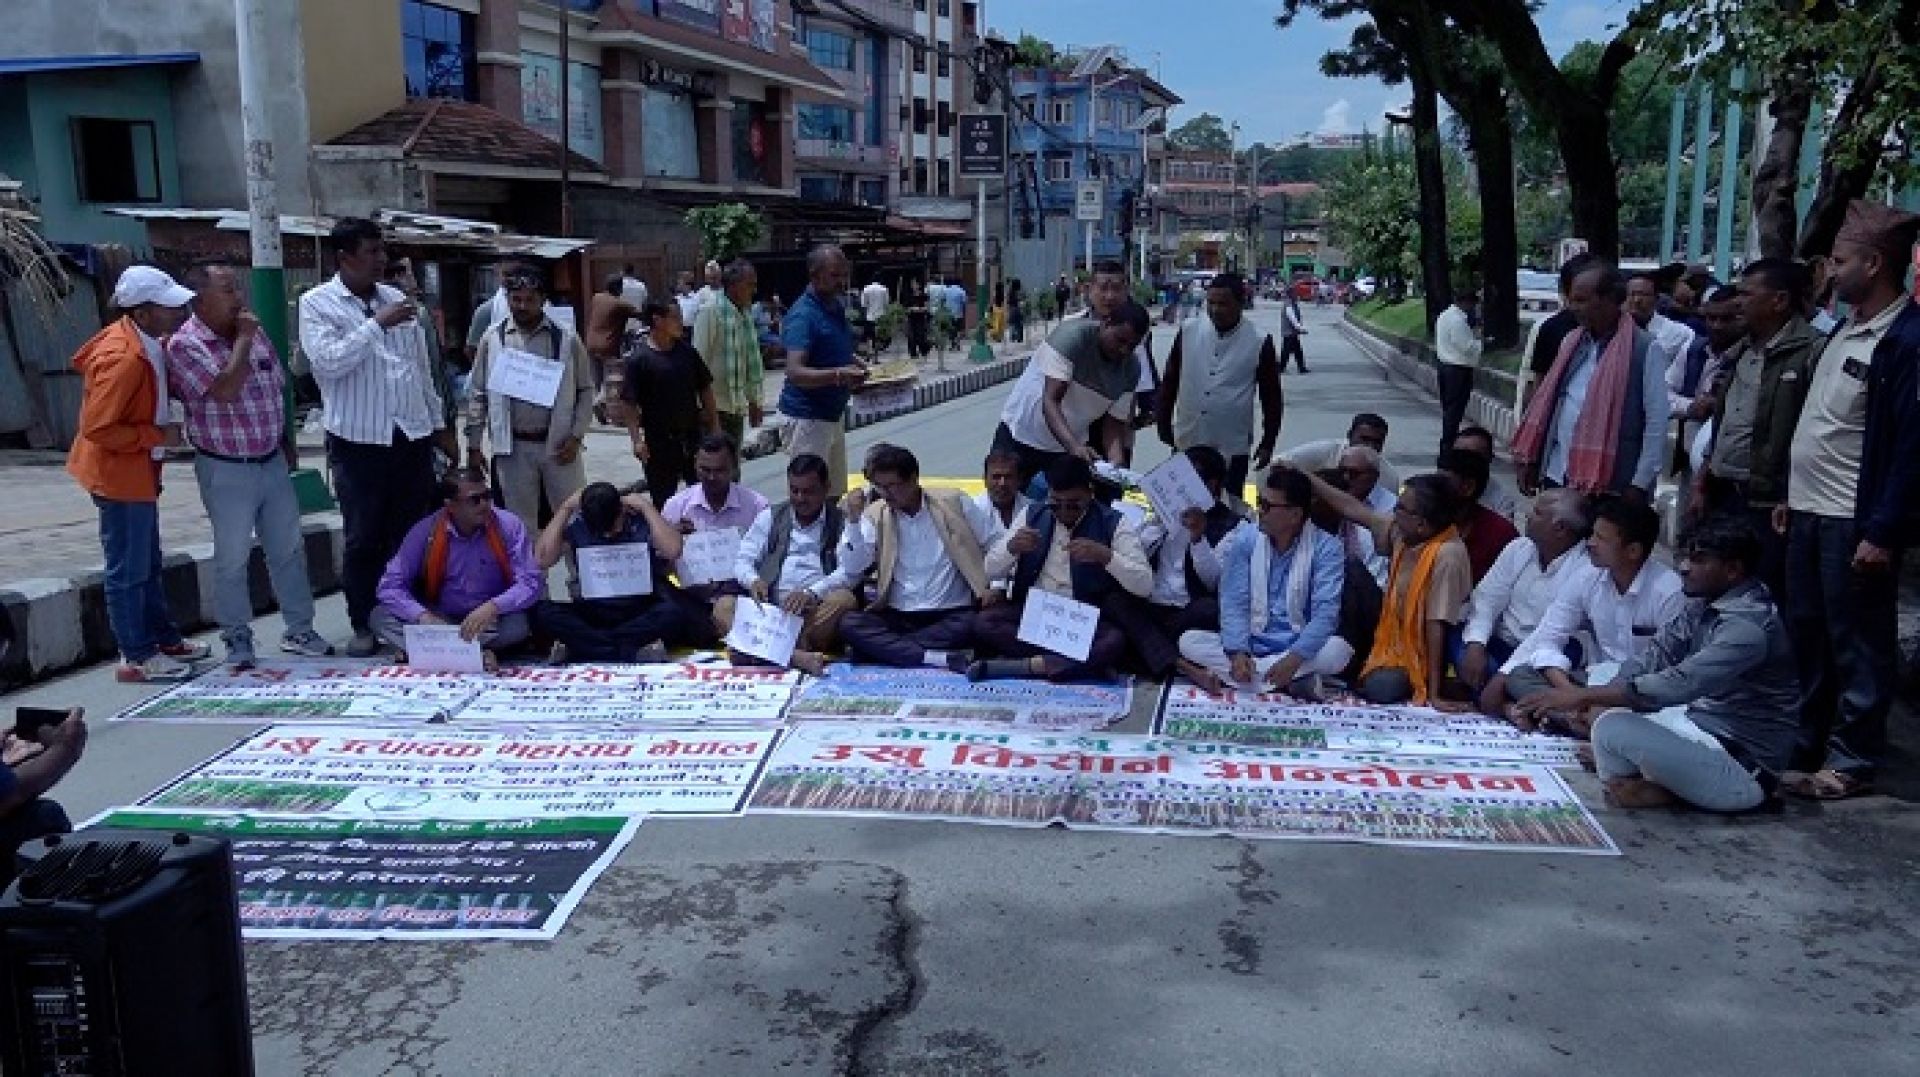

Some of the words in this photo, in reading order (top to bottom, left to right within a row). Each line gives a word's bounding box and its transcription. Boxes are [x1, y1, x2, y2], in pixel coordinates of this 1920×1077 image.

[248, 737, 323, 757] उखु
[327, 739, 484, 758] उत्पादक
[646, 739, 760, 758] नेपाल
[811, 743, 929, 768] उखु
[950, 743, 1173, 775] किसान
[1198, 757, 1539, 795] आन्दोलन
